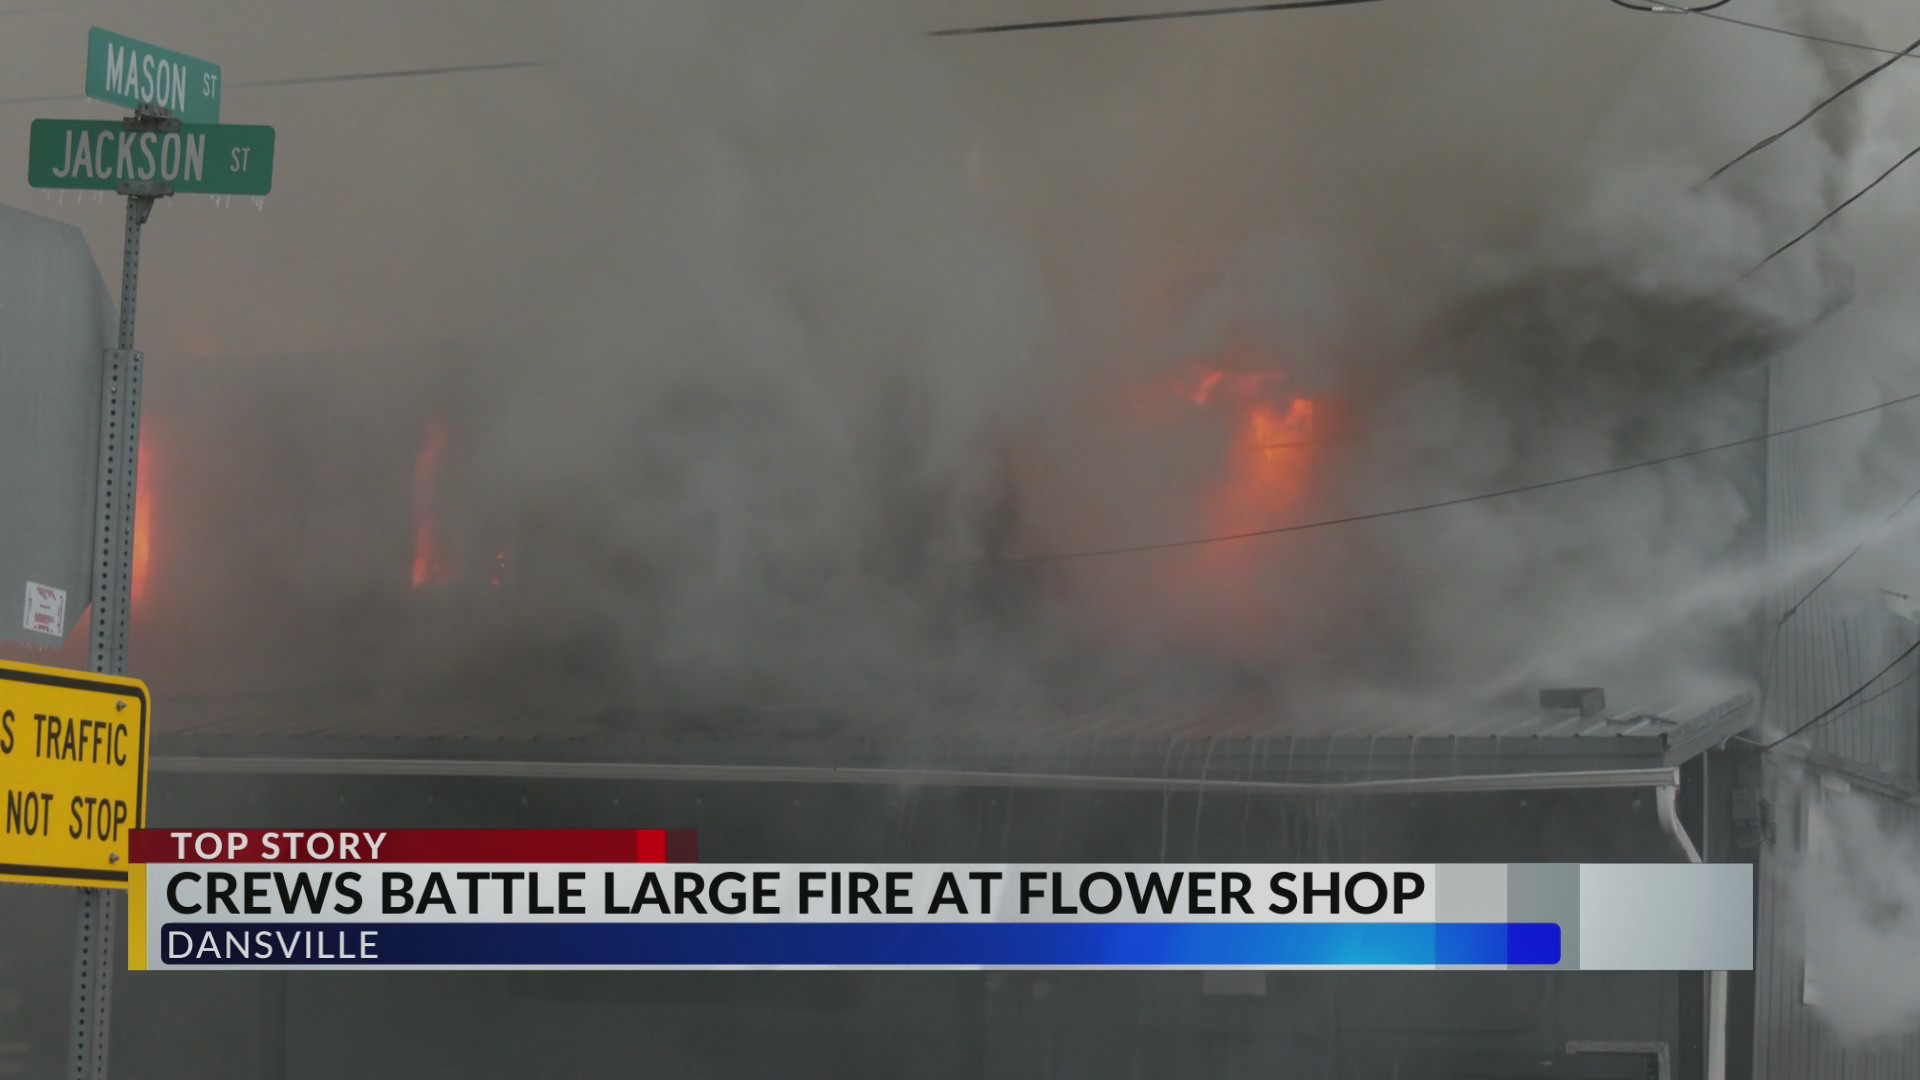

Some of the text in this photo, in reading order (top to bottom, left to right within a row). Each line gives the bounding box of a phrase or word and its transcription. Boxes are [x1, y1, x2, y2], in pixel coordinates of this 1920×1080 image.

[106, 42, 217, 113] MASON ST
[52, 130, 250, 181] JACKSON ST
[33, 713, 128, 766] TRAFFIC
[6, 789, 127, 842] NOT STOP
